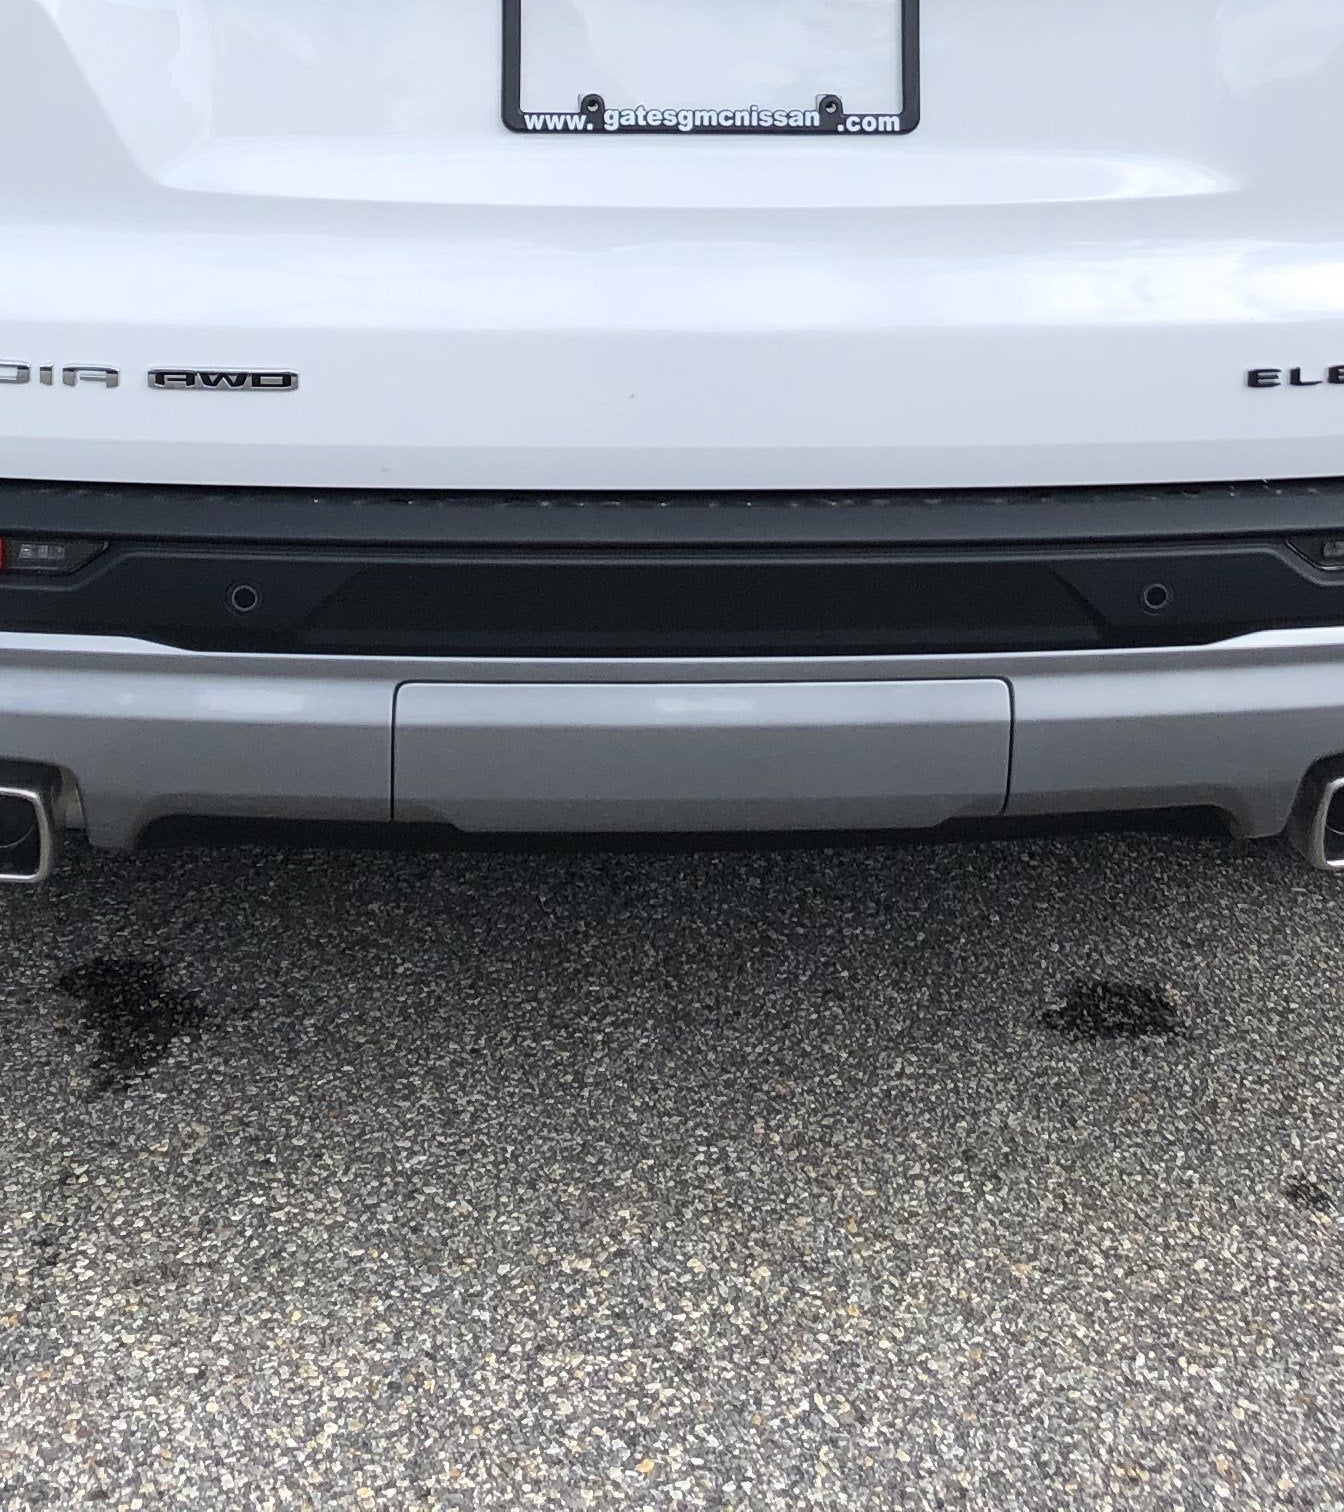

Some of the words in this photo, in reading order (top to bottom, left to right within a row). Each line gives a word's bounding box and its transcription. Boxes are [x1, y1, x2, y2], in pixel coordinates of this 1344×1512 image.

[524, 113, 594, 131] www.
[603, 105, 820, 130] gatesgmcnissan
[837, 114, 900, 132] .com
[154, 371, 293, 387] AWD
